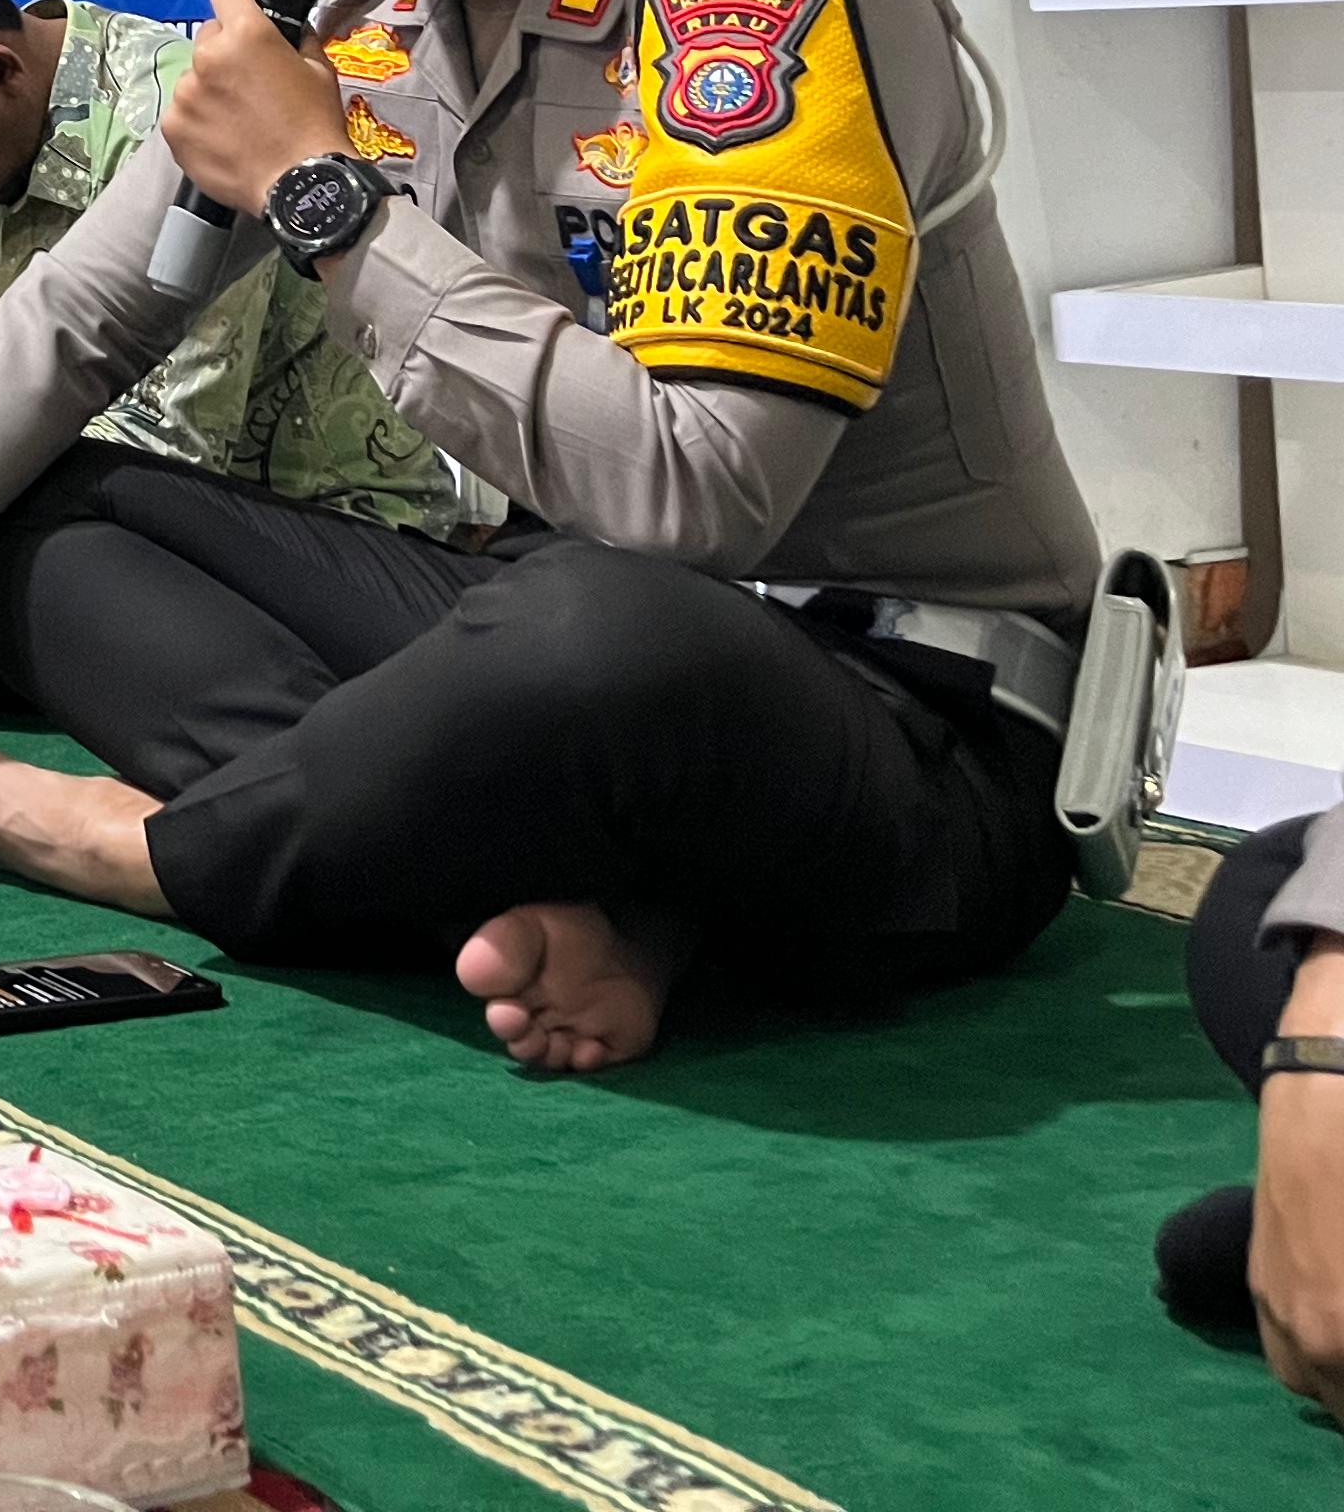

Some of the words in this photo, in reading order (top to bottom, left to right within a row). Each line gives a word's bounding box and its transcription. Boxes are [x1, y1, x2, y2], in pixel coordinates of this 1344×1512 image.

[686, 13, 769, 32] RIAU
[662, 296, 705, 324] LK
[722, 298, 815, 342] 2024
